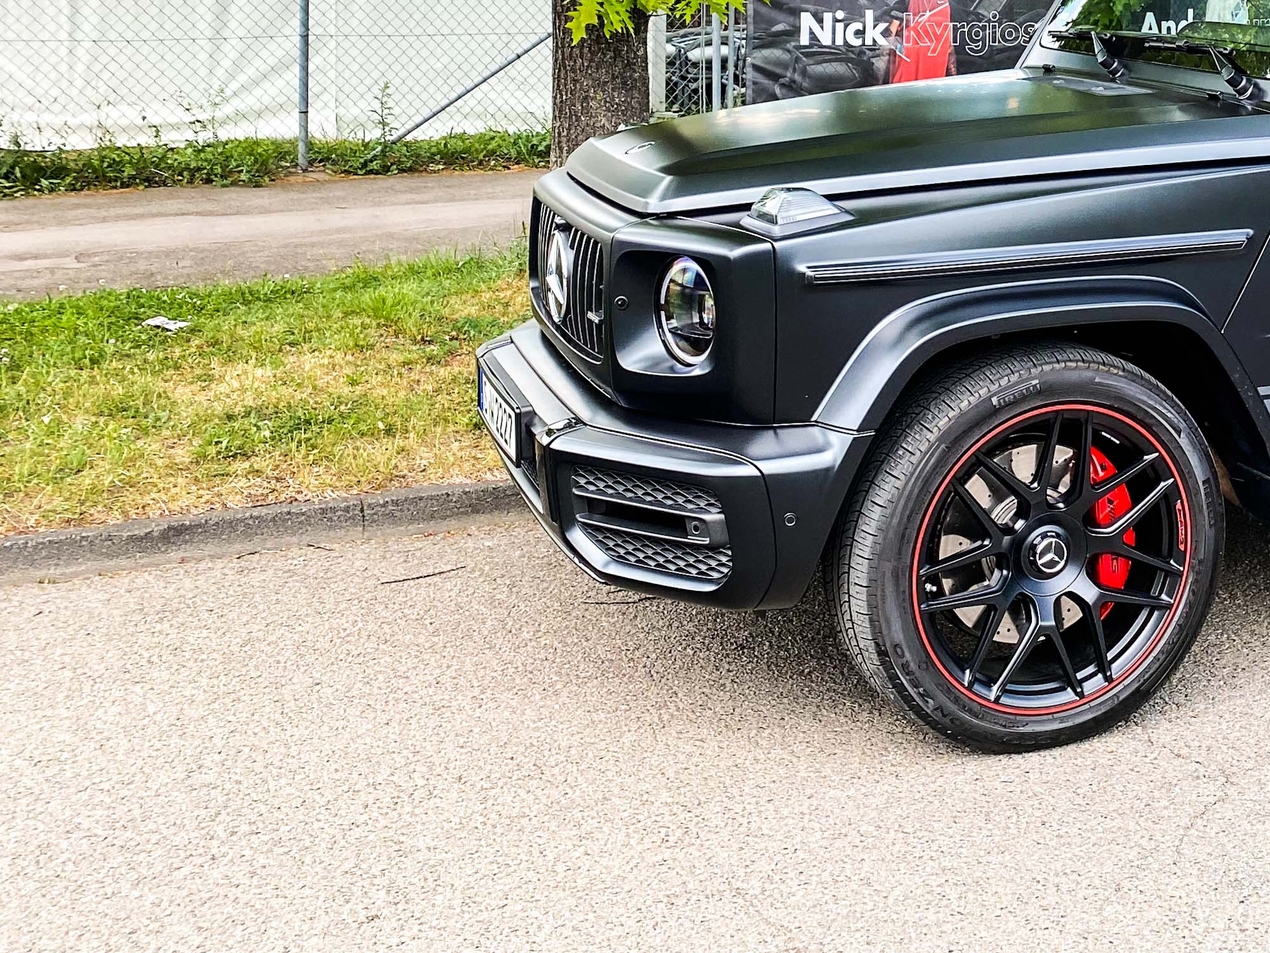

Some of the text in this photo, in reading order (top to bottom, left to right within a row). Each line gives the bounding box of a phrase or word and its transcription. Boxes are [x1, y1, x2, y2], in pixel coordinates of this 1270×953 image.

[800, 9, 1037, 56] Nick Kyrgios
[1140, 9, 1194, 36] And
